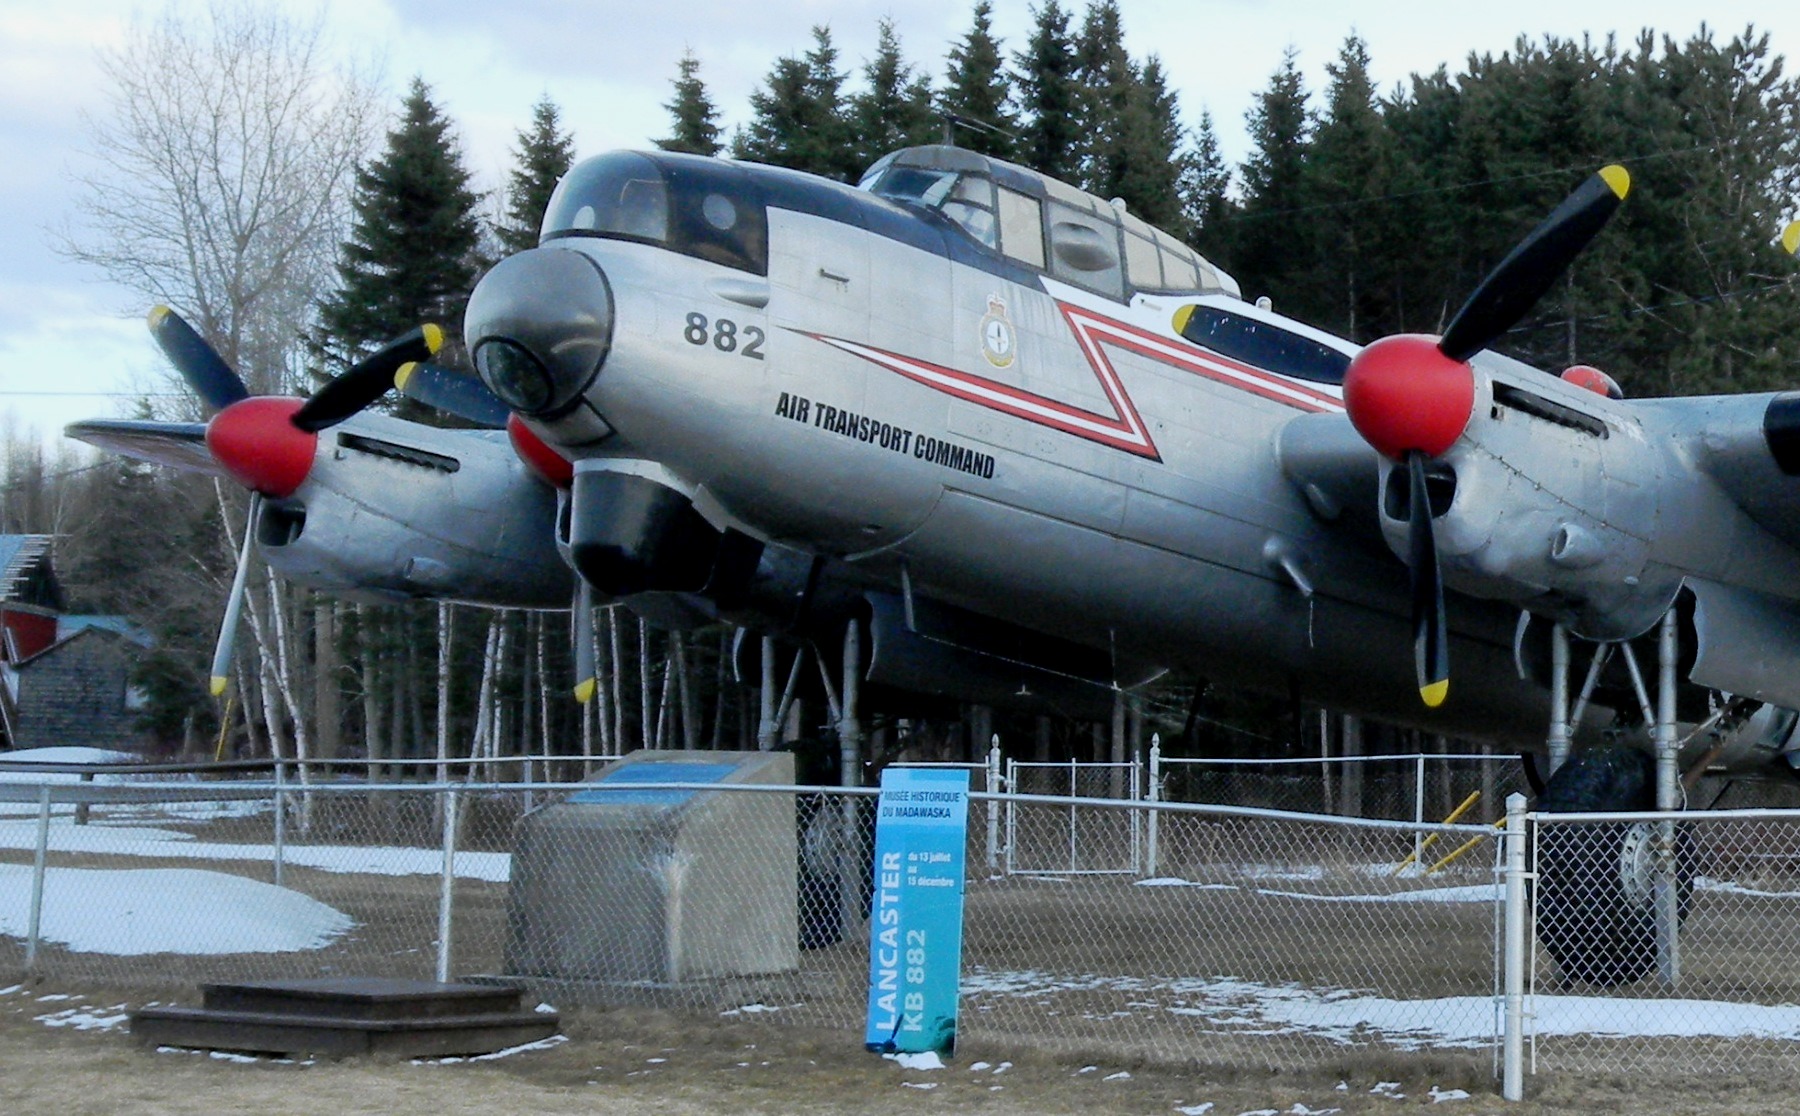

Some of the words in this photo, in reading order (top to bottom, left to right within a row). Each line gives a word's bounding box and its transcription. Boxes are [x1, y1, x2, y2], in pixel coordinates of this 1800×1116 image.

[684, 312, 766, 361] 882
[775, 392, 810, 424] AIR
[815, 402, 913, 454] TRANSPORT
[914, 434, 996, 480] COMMAND
[882, 806, 894, 817] DU
[895, 807, 951, 819] MADAWASKA
[884, 790, 910, 802] MUSÉE
[911, 791, 960, 803] HISTORIQUE
[908, 852, 918, 861] du
[929, 852, 951, 864] juillet
[917, 875, 955, 888] décembre
[876, 852, 901, 1031] LANCASTER
[906, 929, 925, 985] 882
[903, 992, 925, 1032] KB
